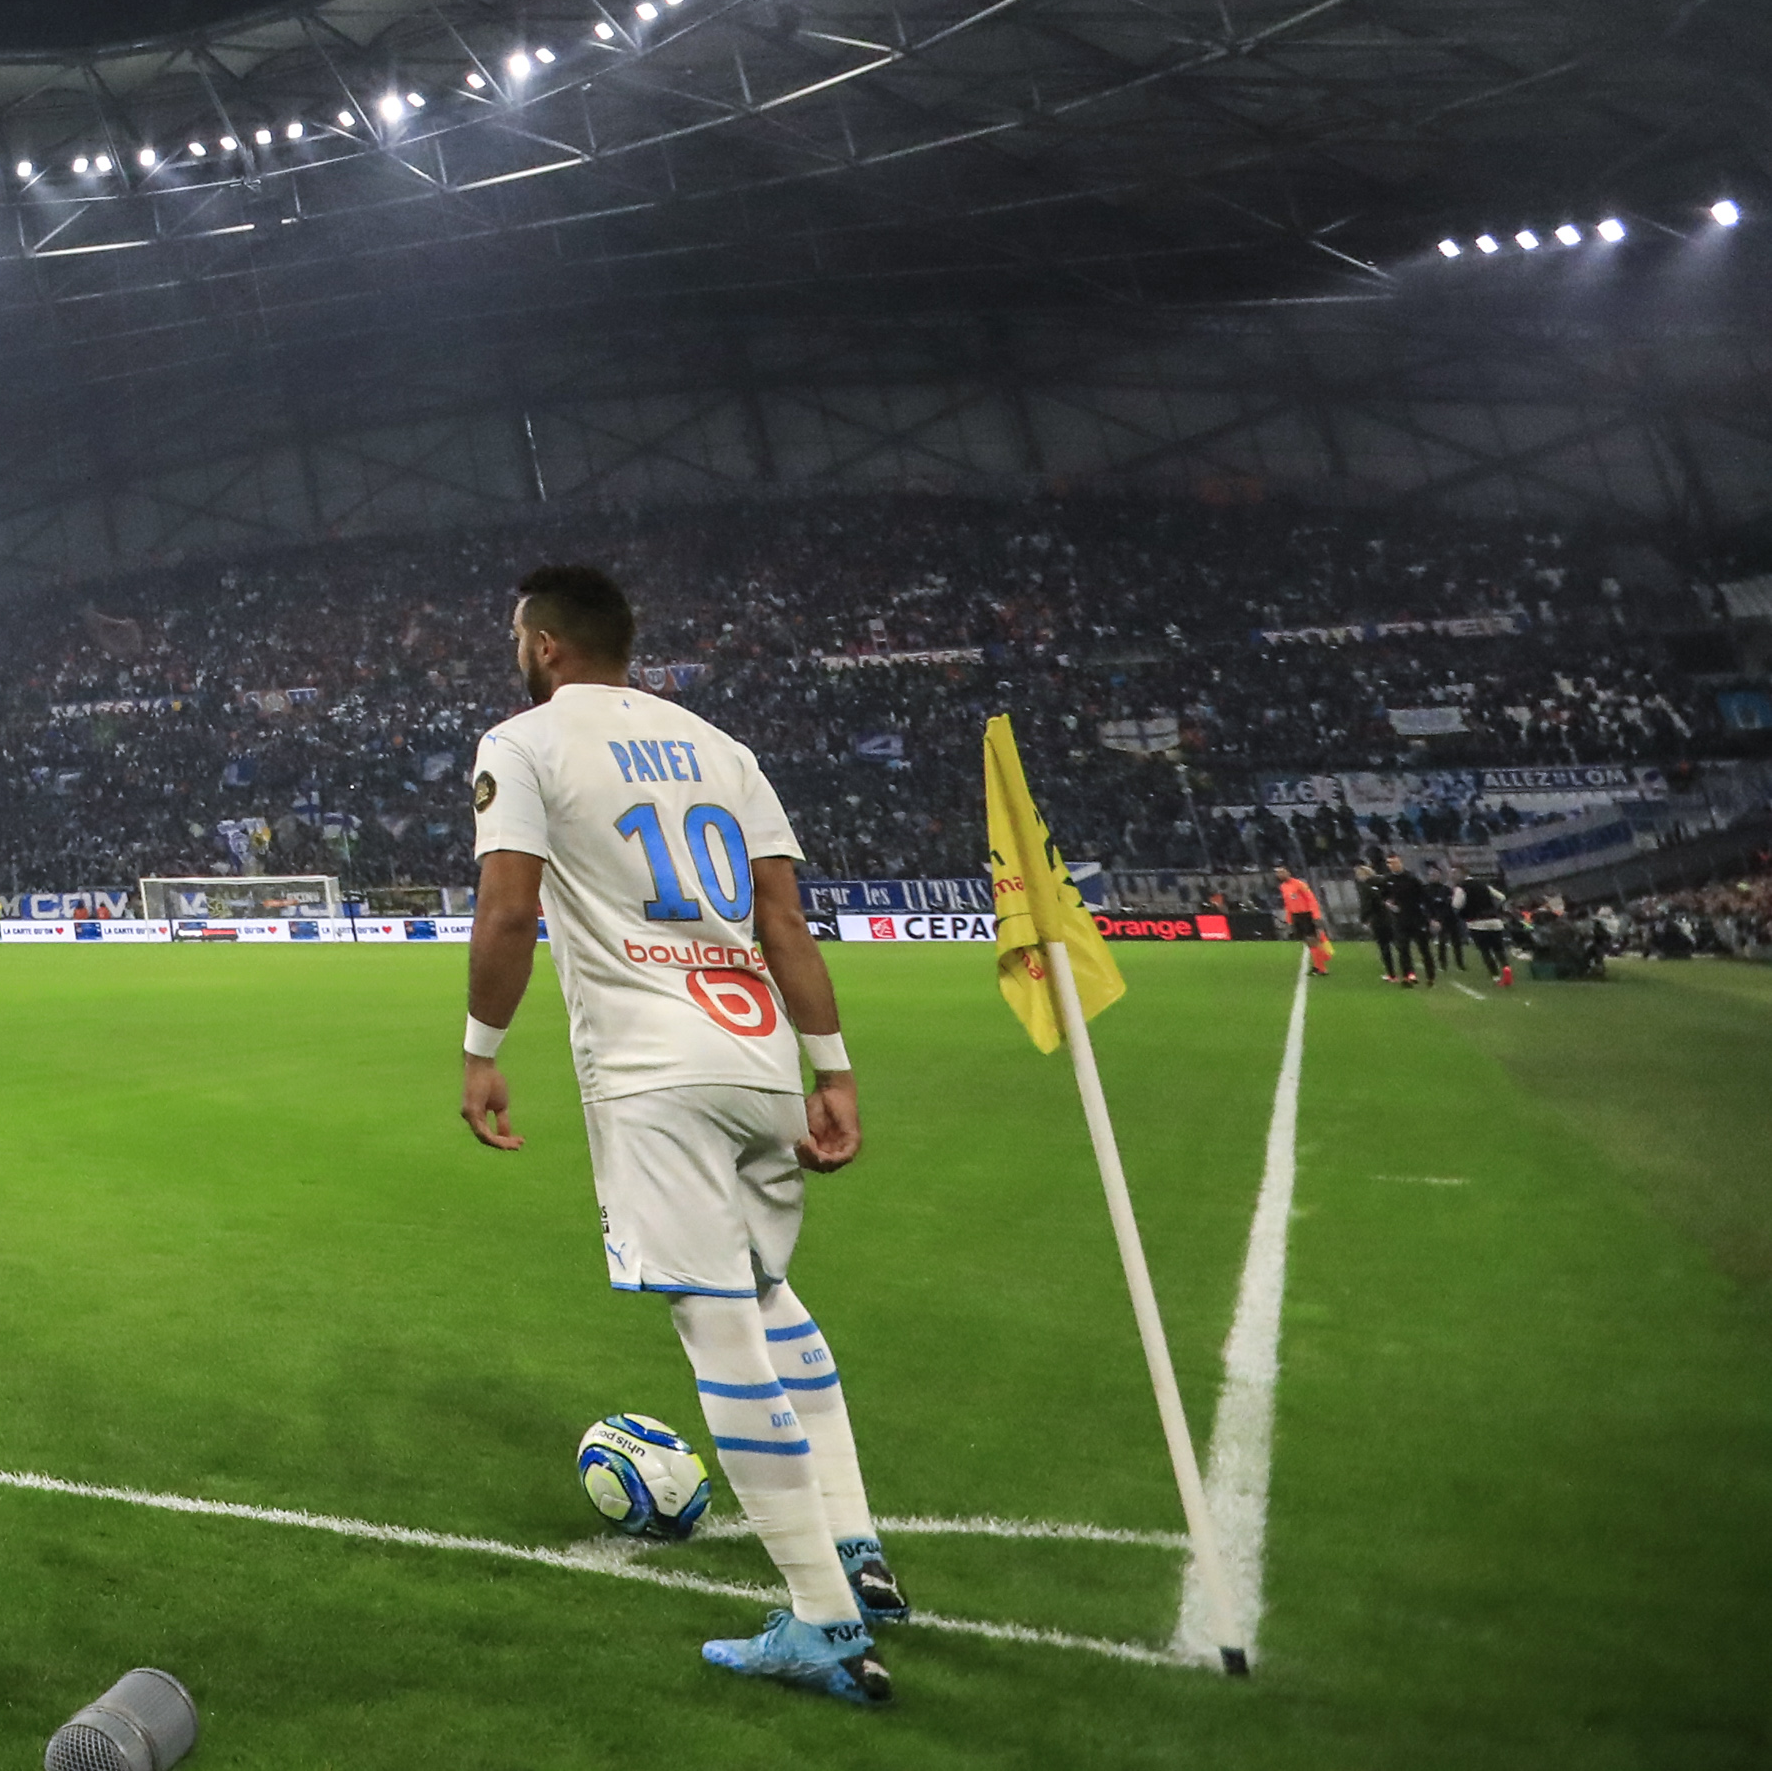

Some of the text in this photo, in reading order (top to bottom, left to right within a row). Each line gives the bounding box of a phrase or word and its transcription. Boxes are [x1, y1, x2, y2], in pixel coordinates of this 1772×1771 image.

[608, 740, 702, 782] PAYET
[1484, 770, 1552, 787] ALLEZ
[613, 801, 753, 922] 10
[862, 880, 891, 906] les
[904, 916, 997, 940] CEPA
[1094, 915, 1192, 940] Orange
